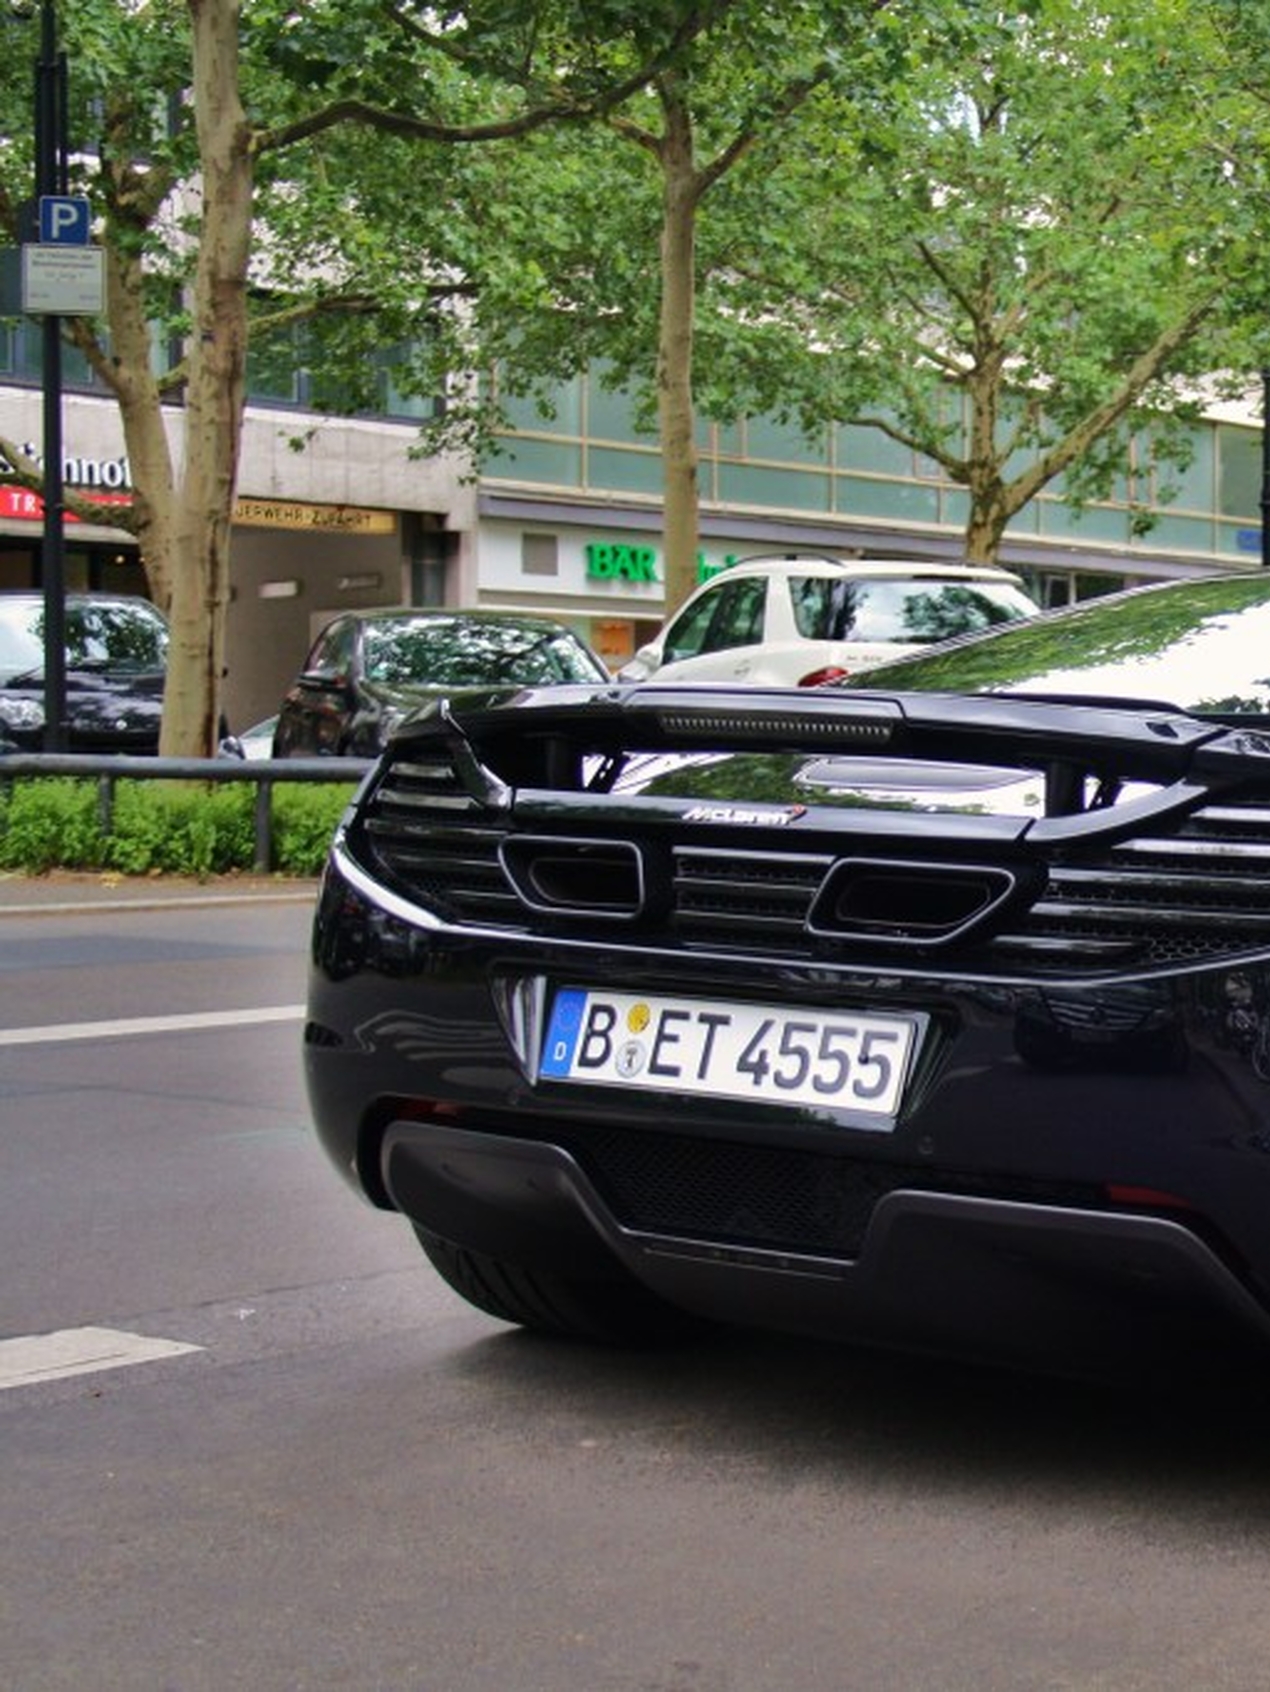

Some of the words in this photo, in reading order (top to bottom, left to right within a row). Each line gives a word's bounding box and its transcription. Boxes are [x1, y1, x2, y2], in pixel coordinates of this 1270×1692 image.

[51, 203, 79, 238] P
[577, 1003, 618, 1069] B
[647, 1009, 731, 1080] ET
[736, 1019, 899, 1099] 4555
